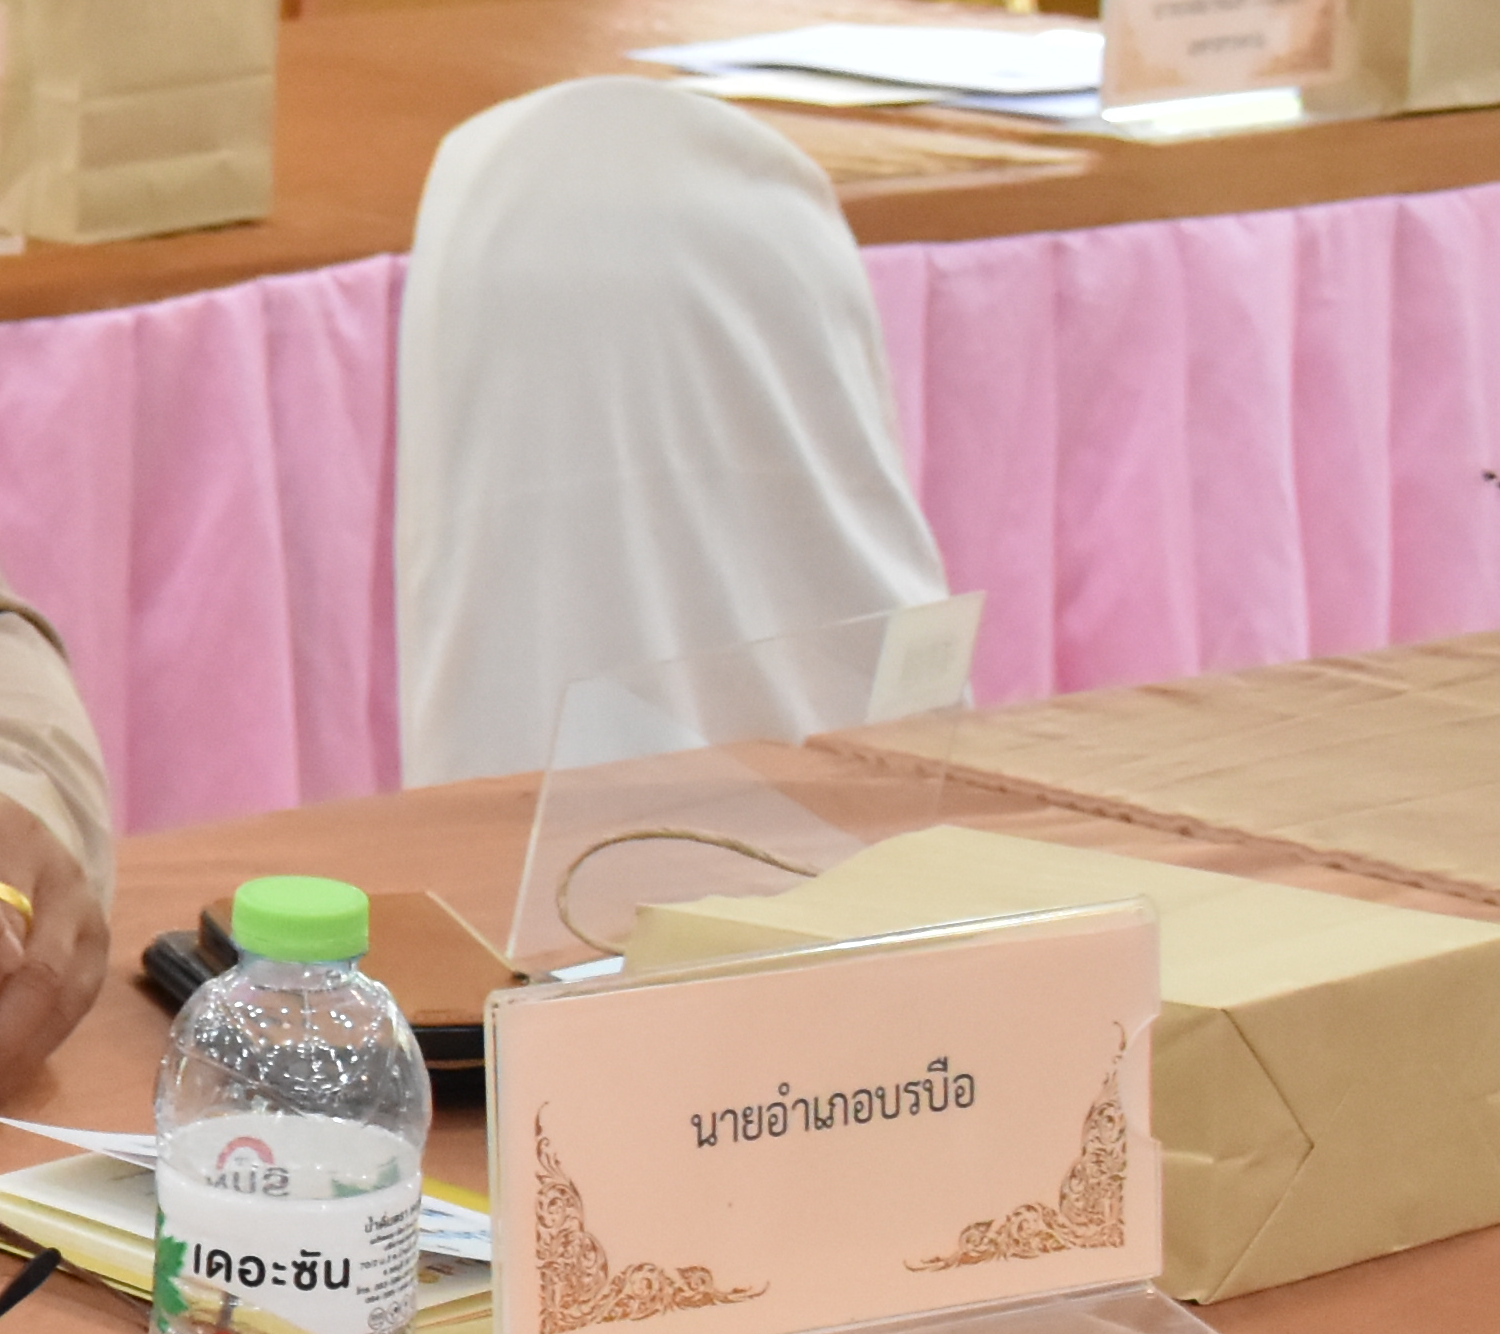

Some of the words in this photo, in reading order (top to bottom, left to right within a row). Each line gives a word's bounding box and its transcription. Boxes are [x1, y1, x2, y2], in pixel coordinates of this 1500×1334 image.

[691, 1056, 974, 1148] นายอำเภอบรบือ
[193, 1242, 350, 1292] เดอะซัน
